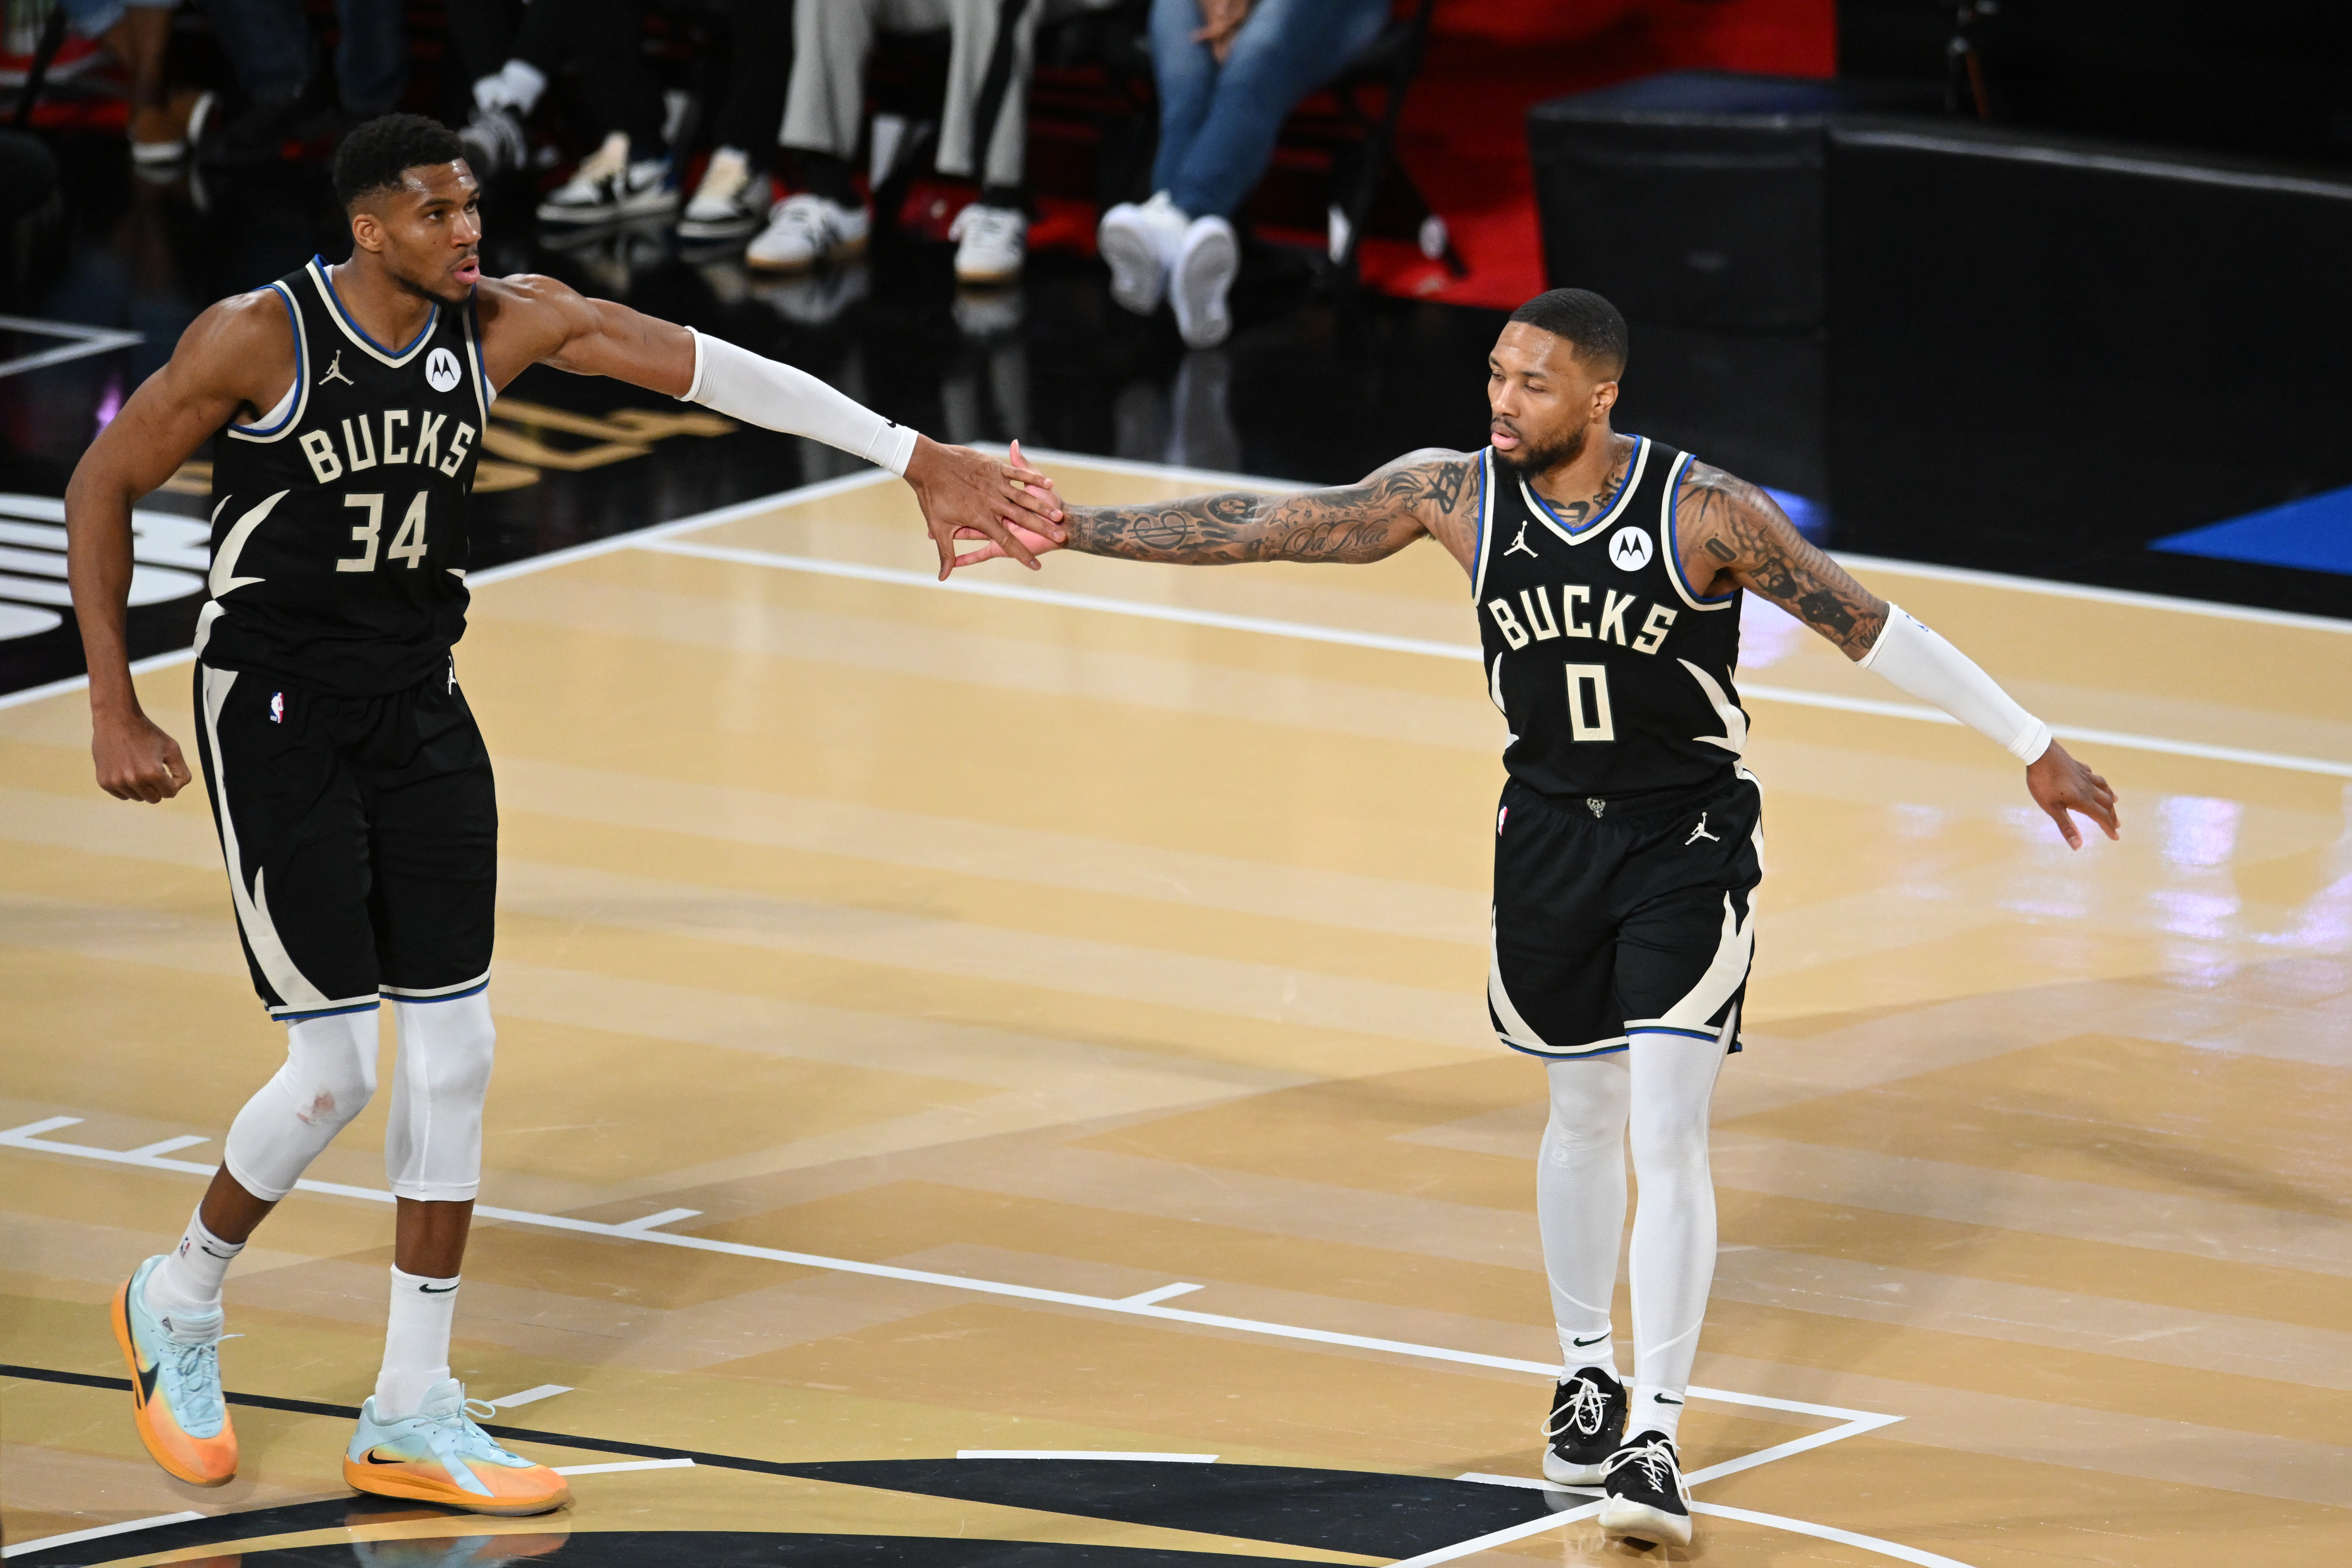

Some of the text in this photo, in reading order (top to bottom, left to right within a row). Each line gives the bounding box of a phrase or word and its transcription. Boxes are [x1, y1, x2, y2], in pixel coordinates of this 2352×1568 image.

[299, 410, 476, 484] BUCKS
[336, 491, 428, 572] 34
[1487, 584, 1678, 655] BUCKS
[1565, 663, 1615, 742] 0
